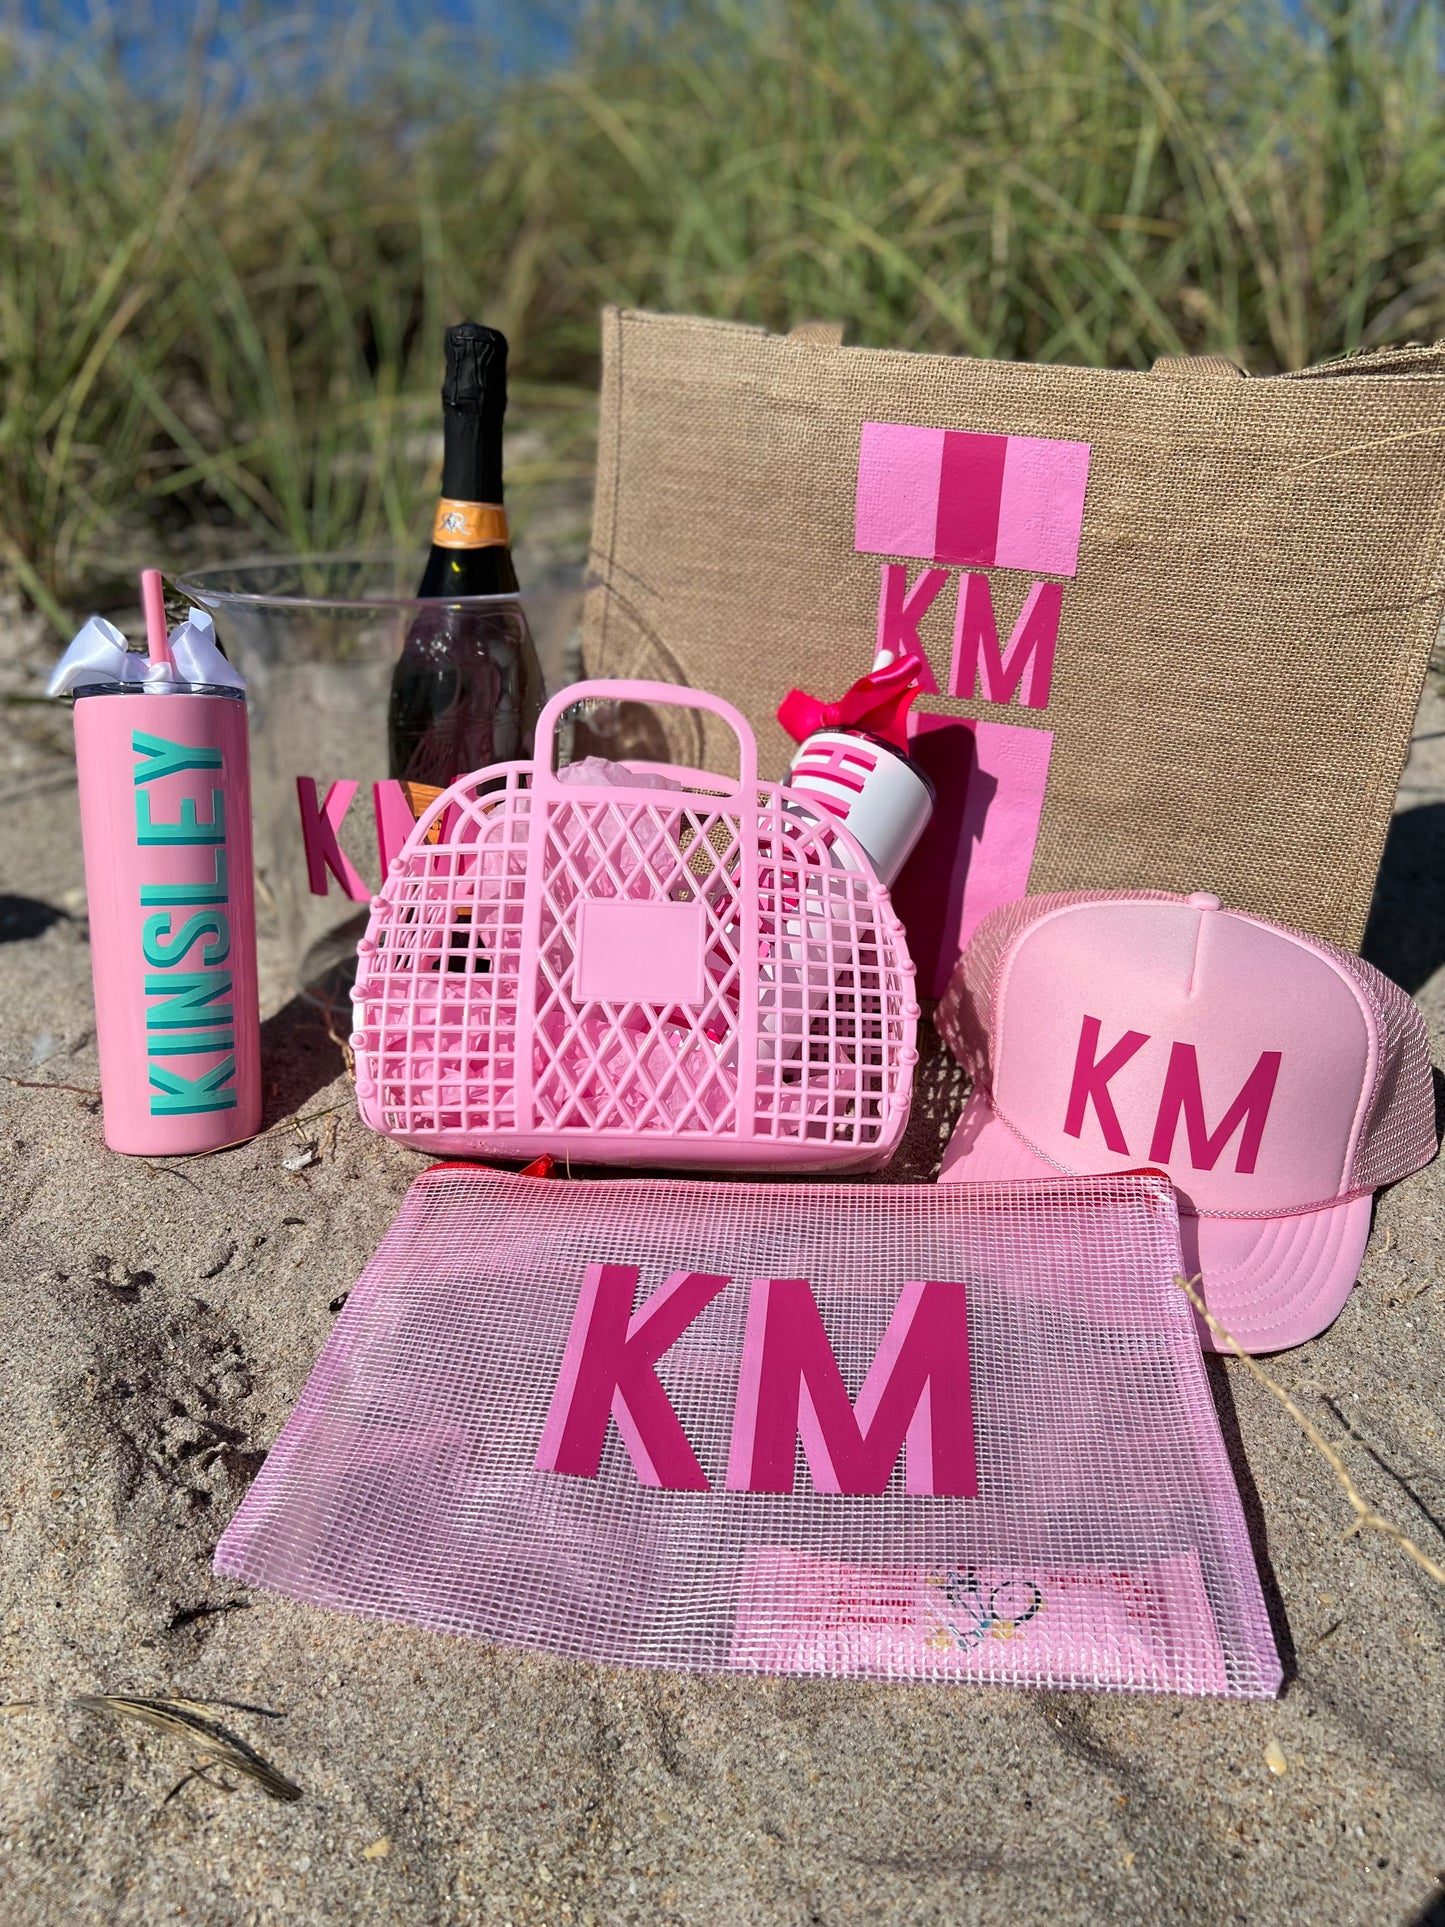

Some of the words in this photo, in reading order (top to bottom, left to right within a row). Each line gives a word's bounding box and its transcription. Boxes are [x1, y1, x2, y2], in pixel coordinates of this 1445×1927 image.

[873, 564, 1064, 710] KM
[131, 729, 238, 1116] KINSLEY
[1062, 1014, 1283, 1175] KM
[533, 1262, 978, 1497] KM
